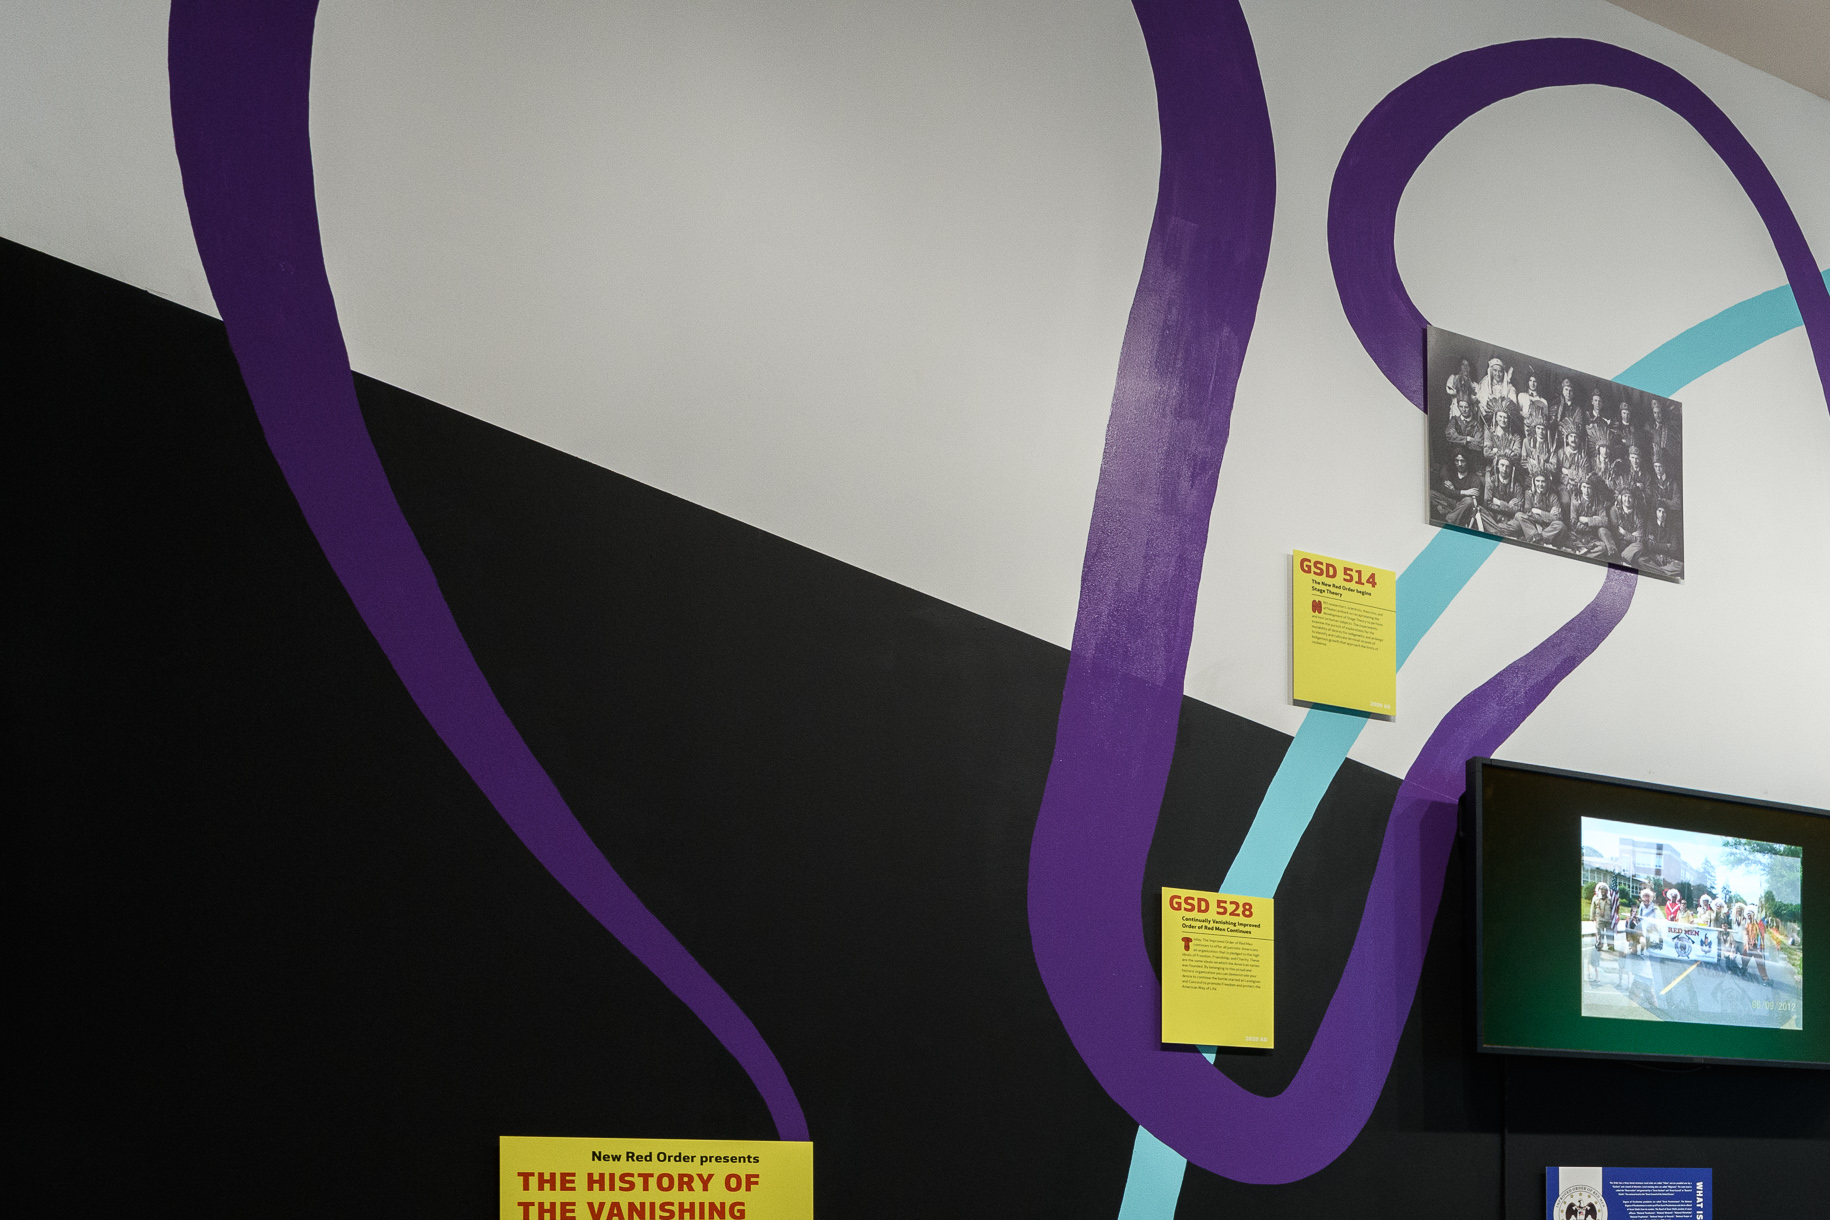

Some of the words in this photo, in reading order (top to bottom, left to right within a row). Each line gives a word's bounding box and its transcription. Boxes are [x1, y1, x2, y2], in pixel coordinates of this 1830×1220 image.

[1300, 558, 1337, 578] GSD
[1343, 567, 1377, 588] 514
[1169, 895, 1209, 913] GSD
[1216, 900, 1253, 918] 528
[1182, 916, 1211, 924] Continually
[592, 1151, 622, 1162] New
[626, 1152, 652, 1162] Red
[657, 1152, 696, 1162] Order
[700, 1155, 759, 1166] presents
[517, 1172, 576, 1191] THE
[587, 1172, 714, 1192] HISTORY
[725, 1174, 759, 1192] OF
[1696, 1182, 1704, 1208] WHAT
[517, 1202, 576, 1220] THE
[587, 1202, 745, 1220] VANISHING
[1696, 1211, 1704, 1220] IS
